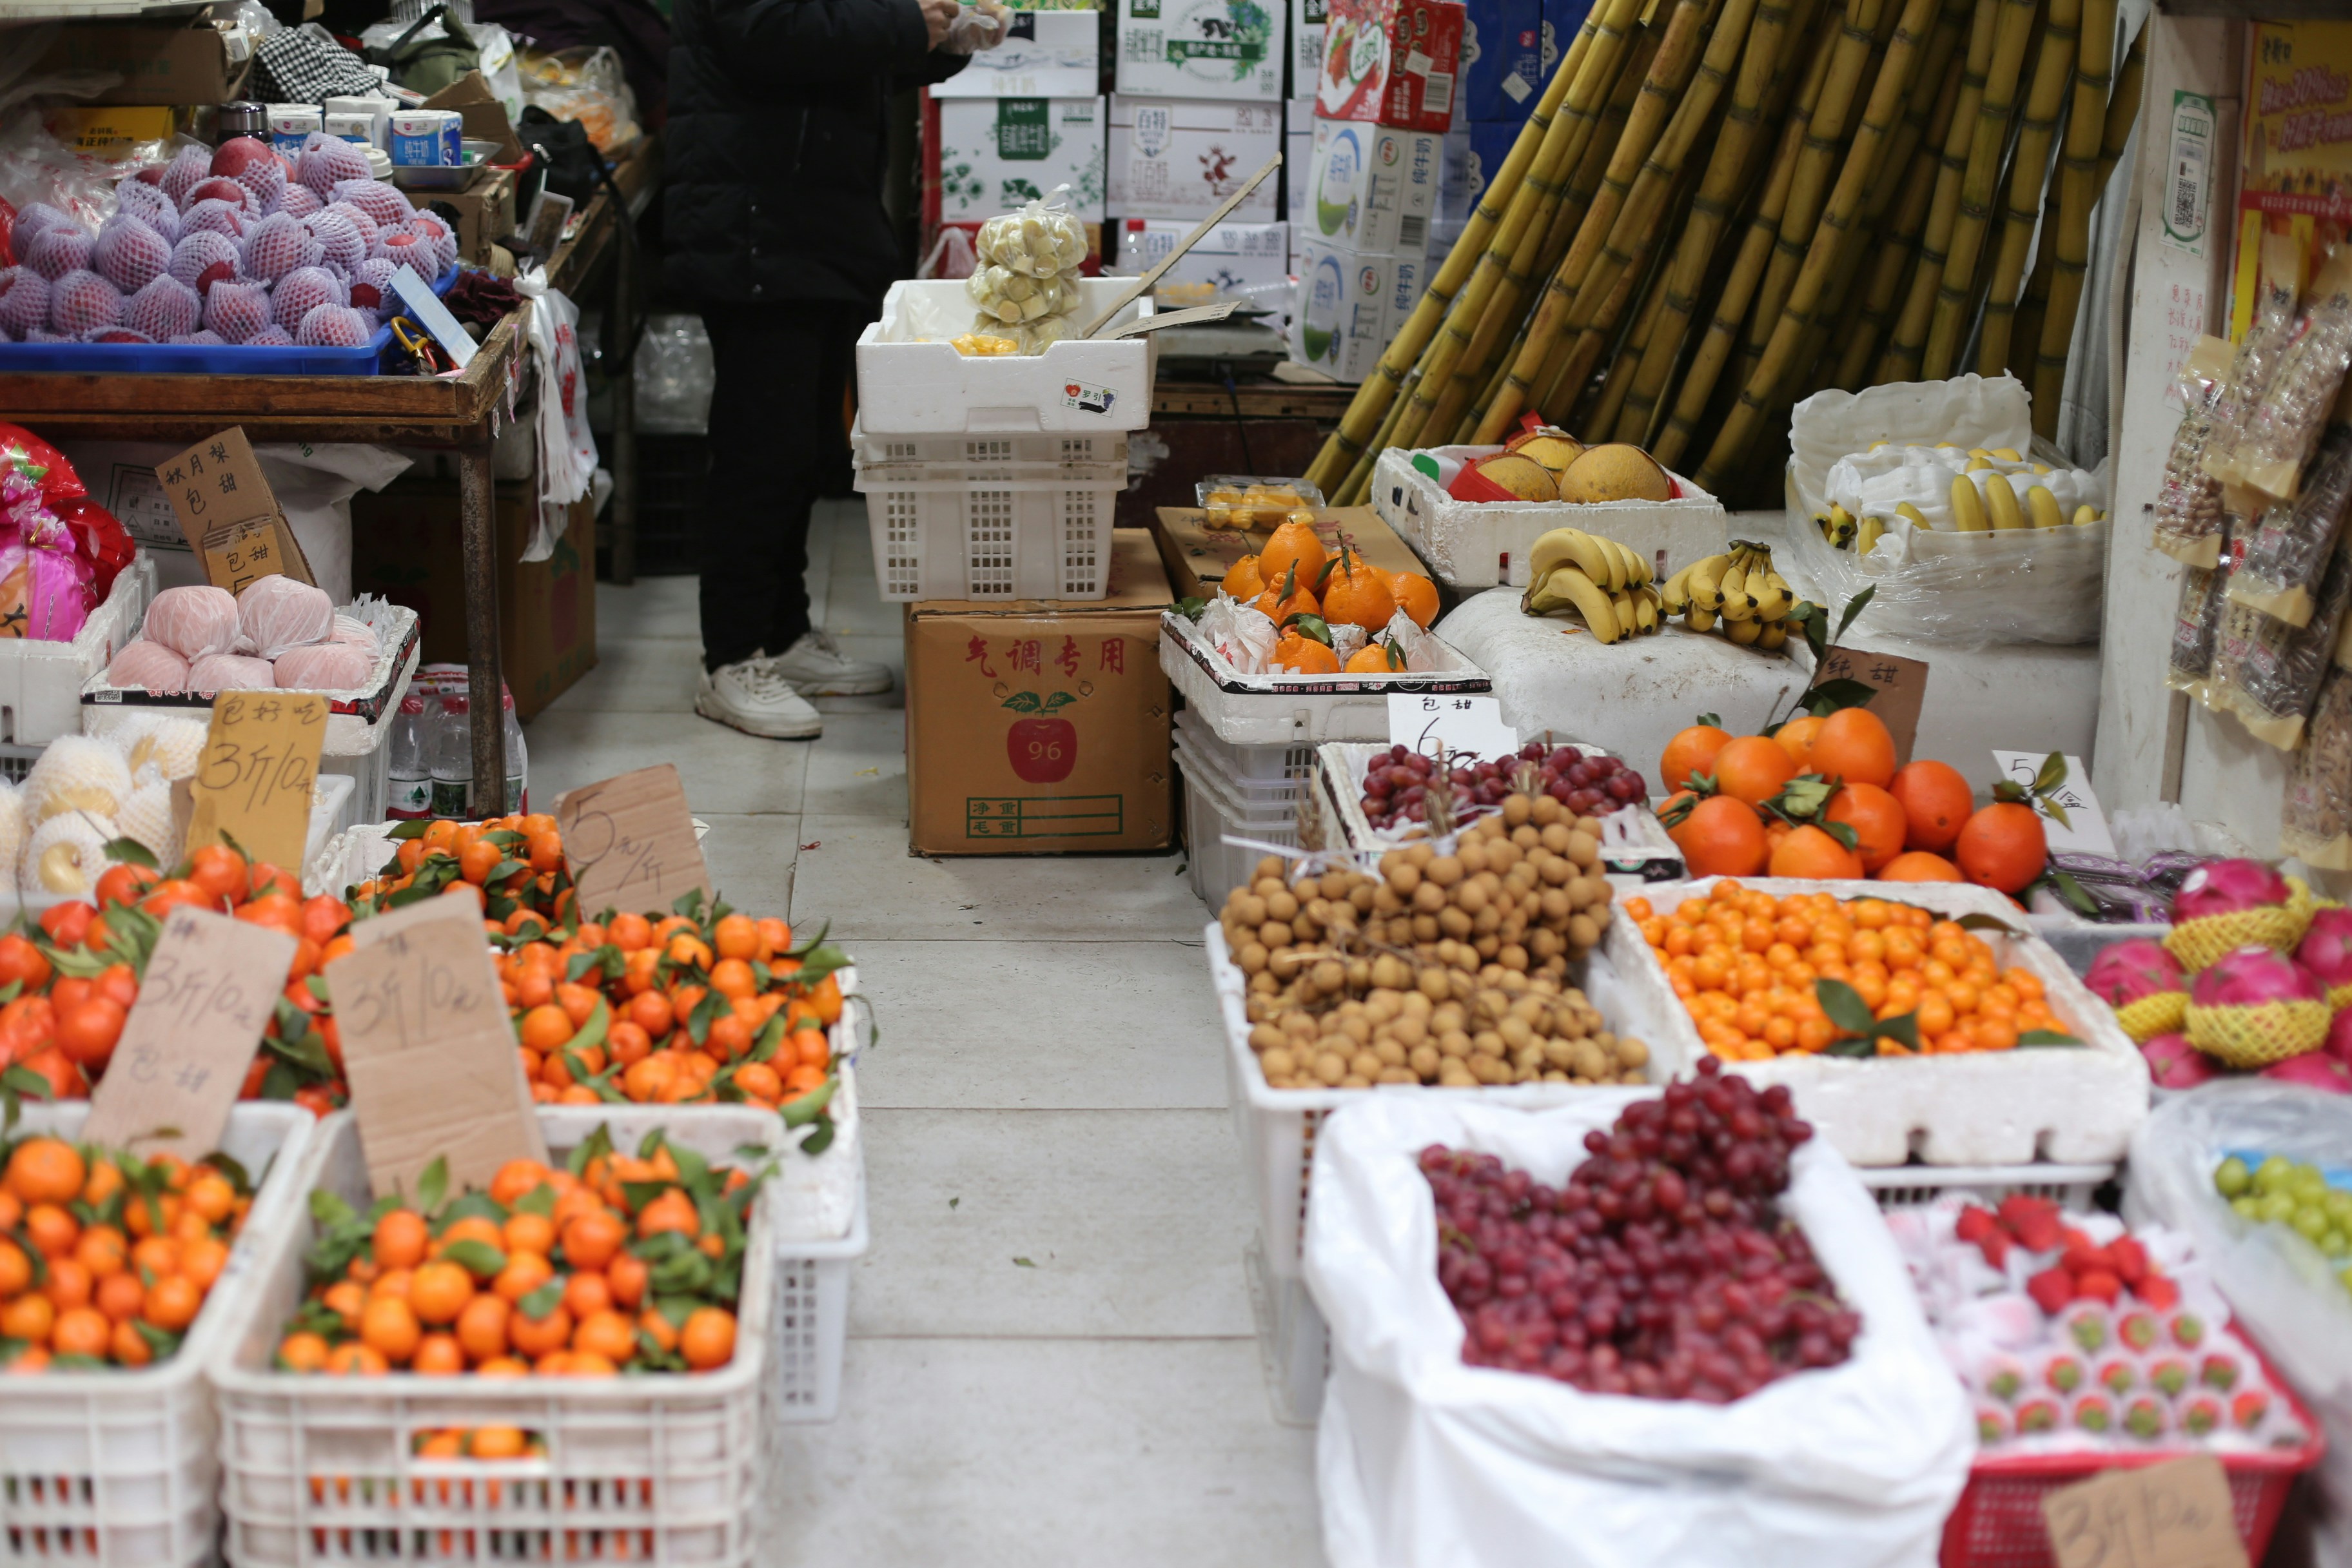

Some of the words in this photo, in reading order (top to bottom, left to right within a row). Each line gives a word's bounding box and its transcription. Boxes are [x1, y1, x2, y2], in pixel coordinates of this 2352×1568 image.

[1413, 137, 1433, 185] 纯牛奶
[1395, 264, 1415, 311] 纯牛奶
[165, 441, 230, 485] 秋月梨
[186, 472, 237, 516] 包甜
[226, 543, 269, 573] 包甜
[965, 634, 1125, 678] 气调专用
[1828, 655, 1899, 683] 纯甜
[222, 696, 322, 725] 包好吃
[1422, 696, 1472, 711] 包甜
[1028, 741, 1062, 761] 96
[973, 802, 1016, 816] 净重
[973, 820, 1016, 835] 毛重
